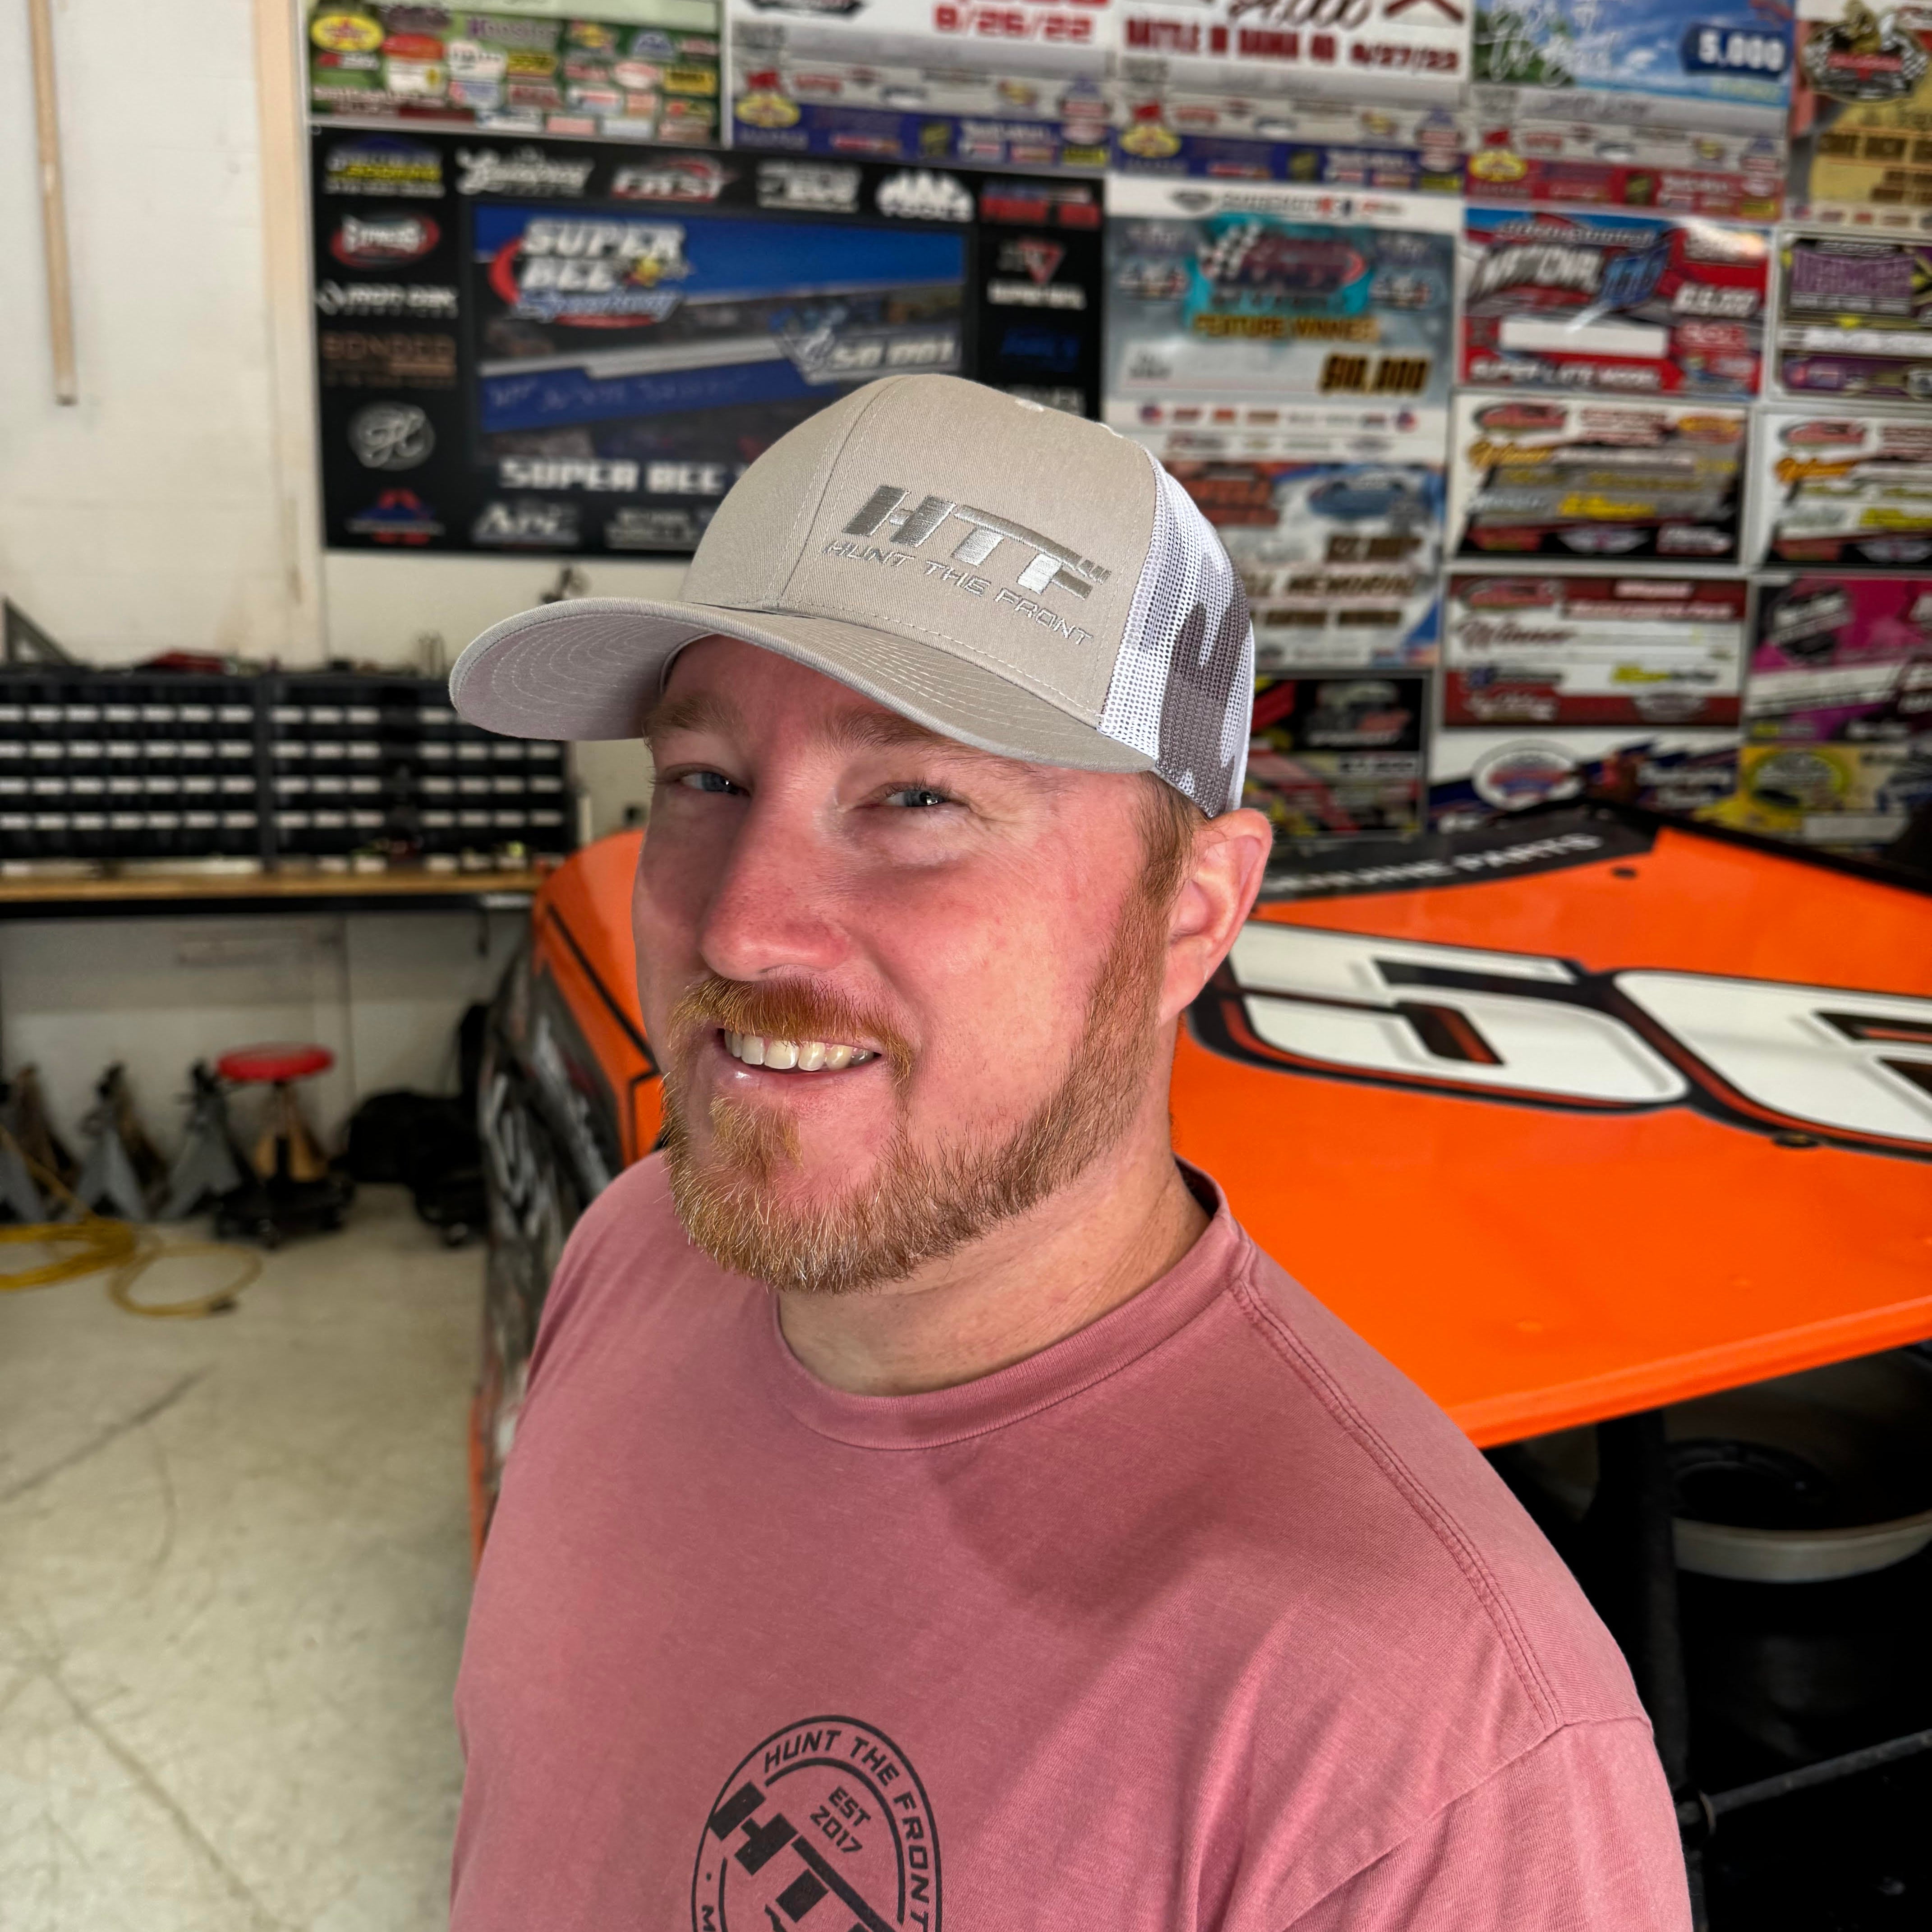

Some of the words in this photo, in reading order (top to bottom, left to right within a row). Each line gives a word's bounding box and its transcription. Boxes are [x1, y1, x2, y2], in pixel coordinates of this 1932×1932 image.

[935, 6, 1093, 44] 8/26/22
[520, 217, 686, 260] SUPER
[499, 455, 639, 492] SUPER
[842, 484, 1111, 601] HTF
[823, 541, 915, 568] HUNT
[925, 560, 992, 597] THE
[994, 587, 1094, 646] FRONT
[810, 1805, 863, 1854] 2017
[828, 1786, 871, 1827] EST
[765, 1730, 842, 1773] HUNT
[849, 1736, 900, 1787] THE
[893, 1790, 930, 1932] FRONT
